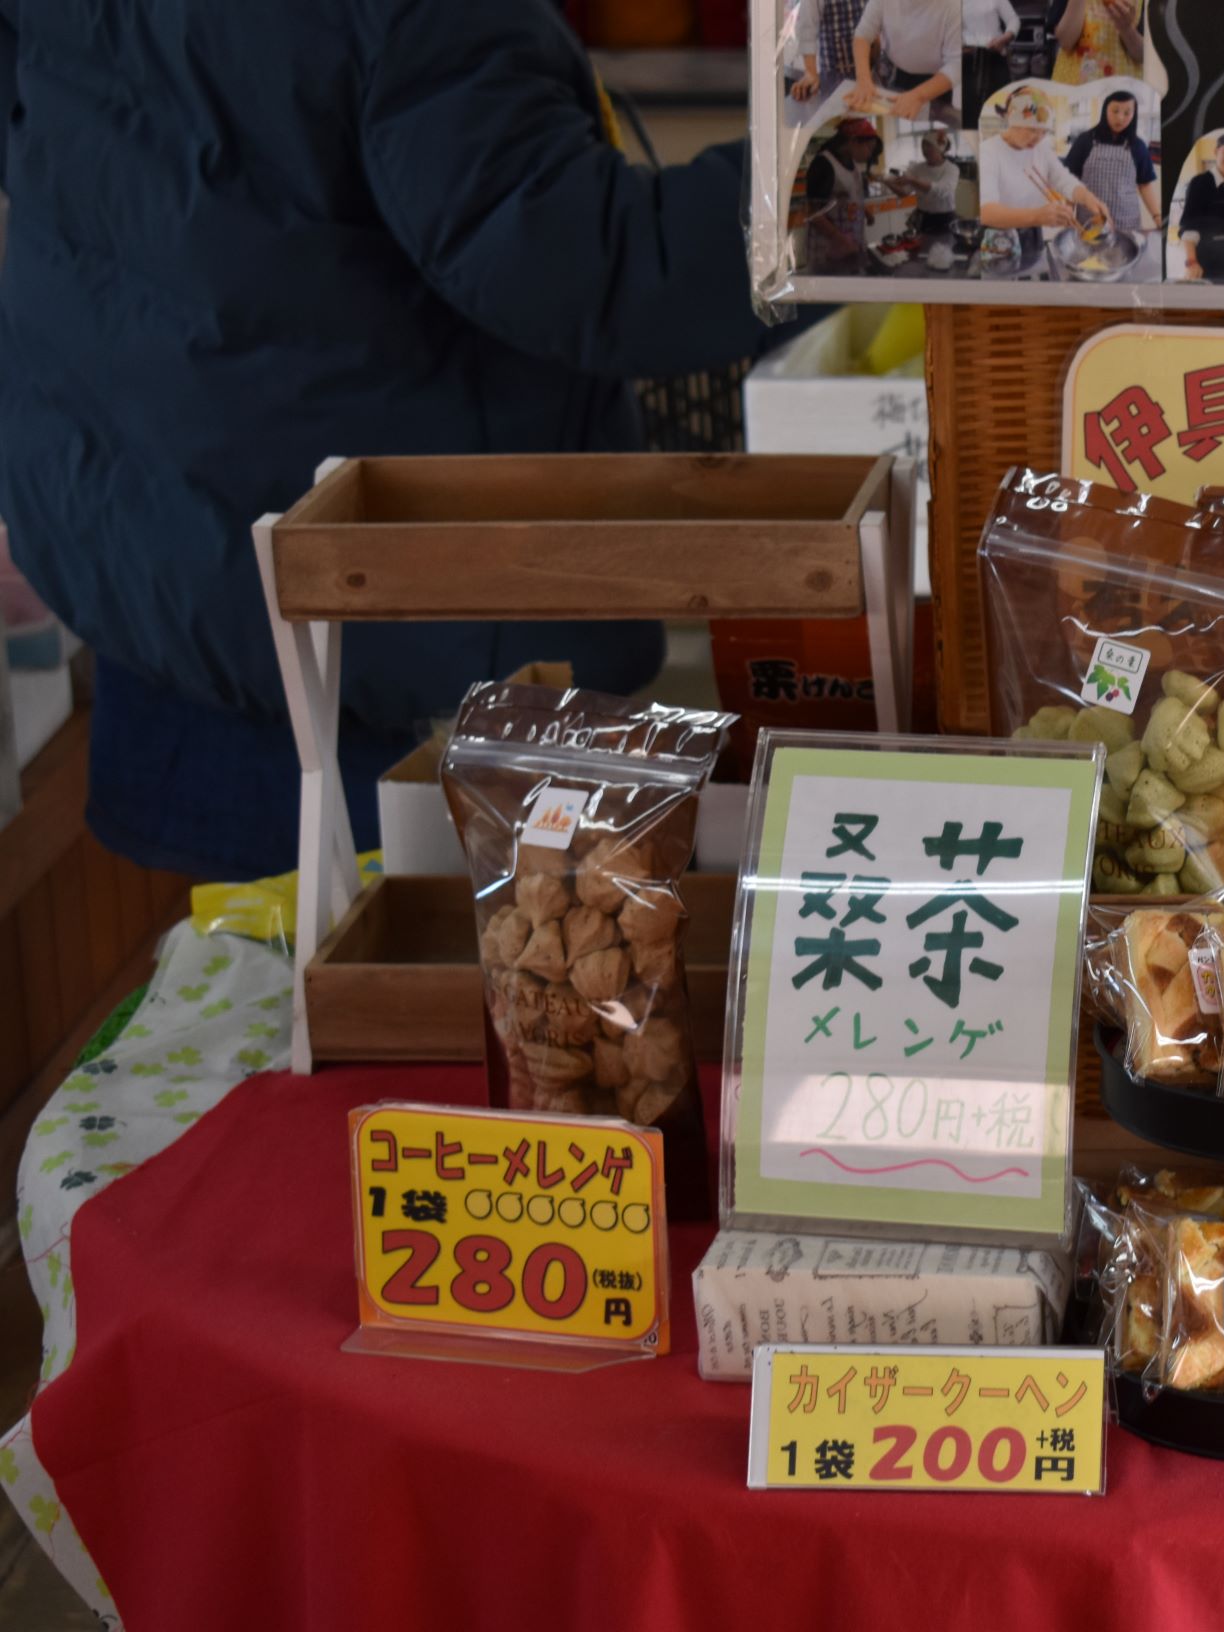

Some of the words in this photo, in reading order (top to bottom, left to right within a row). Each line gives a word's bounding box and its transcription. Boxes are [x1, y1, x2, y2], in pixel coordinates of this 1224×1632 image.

[804, 1006, 1005, 1059] メレンゲ
[370, 1129, 634, 1195] コーヒーメレンゲ
[381, 1229, 588, 1320] 280
[592, 1268, 642, 1292] (税抜)
[604, 1298, 632, 1326] 円
[787, 1364, 1088, 1418] カイザークーヘン
[868, 1424, 1027, 1483] 200
[1034, 1455, 1075, 1481] 円
